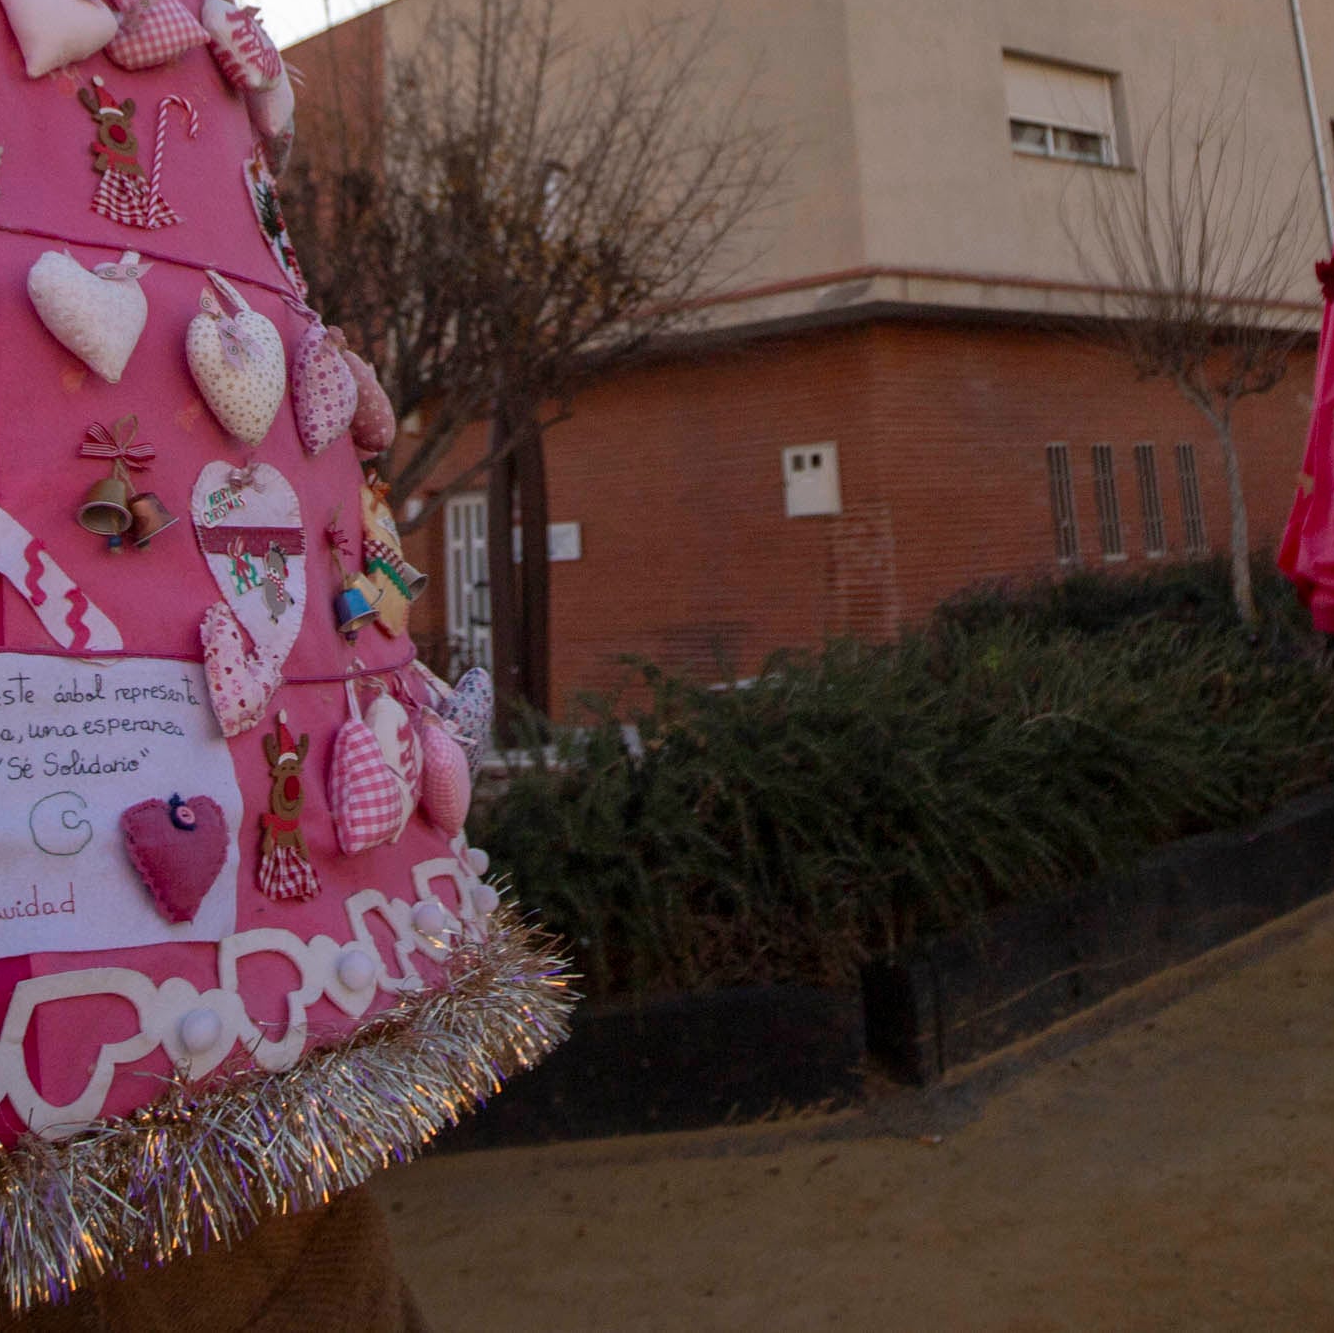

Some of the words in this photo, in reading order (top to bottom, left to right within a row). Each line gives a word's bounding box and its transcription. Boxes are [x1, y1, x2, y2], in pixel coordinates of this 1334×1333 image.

[203, 495, 245, 525] CHRISTMAS
[54, 674, 106, 704] árbol
[115, 675, 201, 705] representa
[28, 723, 79, 740] una
[82, 717, 185, 736] esperanza
